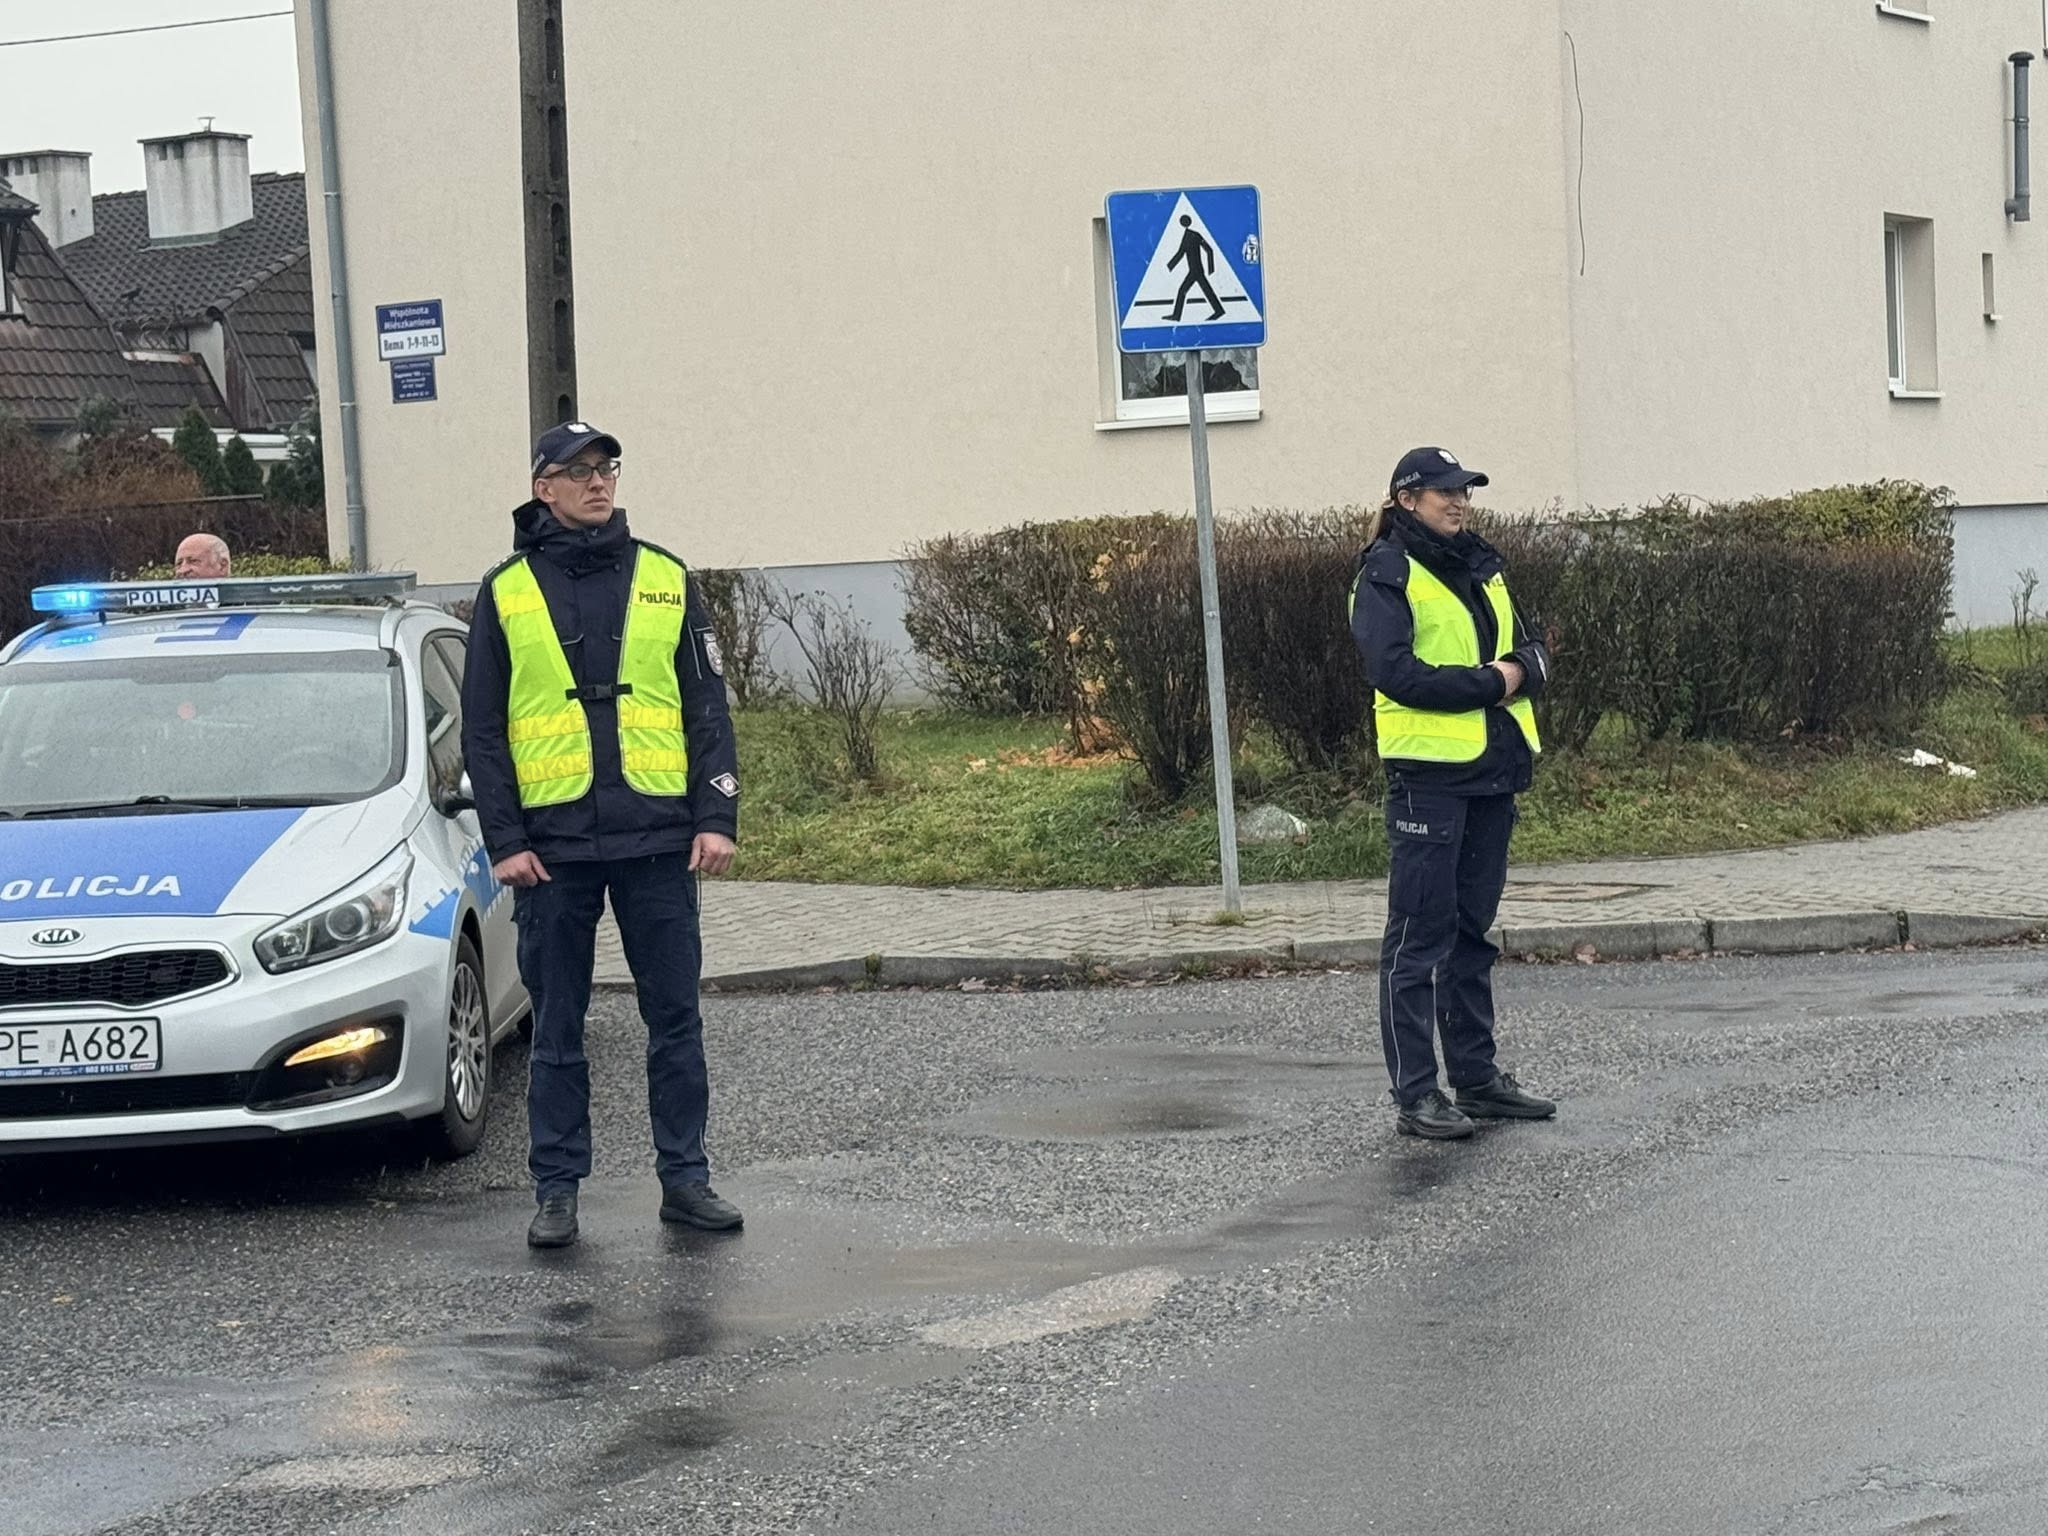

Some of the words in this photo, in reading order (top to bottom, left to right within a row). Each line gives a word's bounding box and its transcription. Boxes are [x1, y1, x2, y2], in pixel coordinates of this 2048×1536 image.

[1396, 471, 1421, 489] POLICJA
[128, 588, 217, 605] POLICJA
[638, 591, 683, 607] POLICJA
[1396, 819, 1429, 835] POLICJA
[0, 875, 182, 901] OLICJA
[0, 1030, 40, 1064] PE
[59, 1025, 150, 1063] A682
